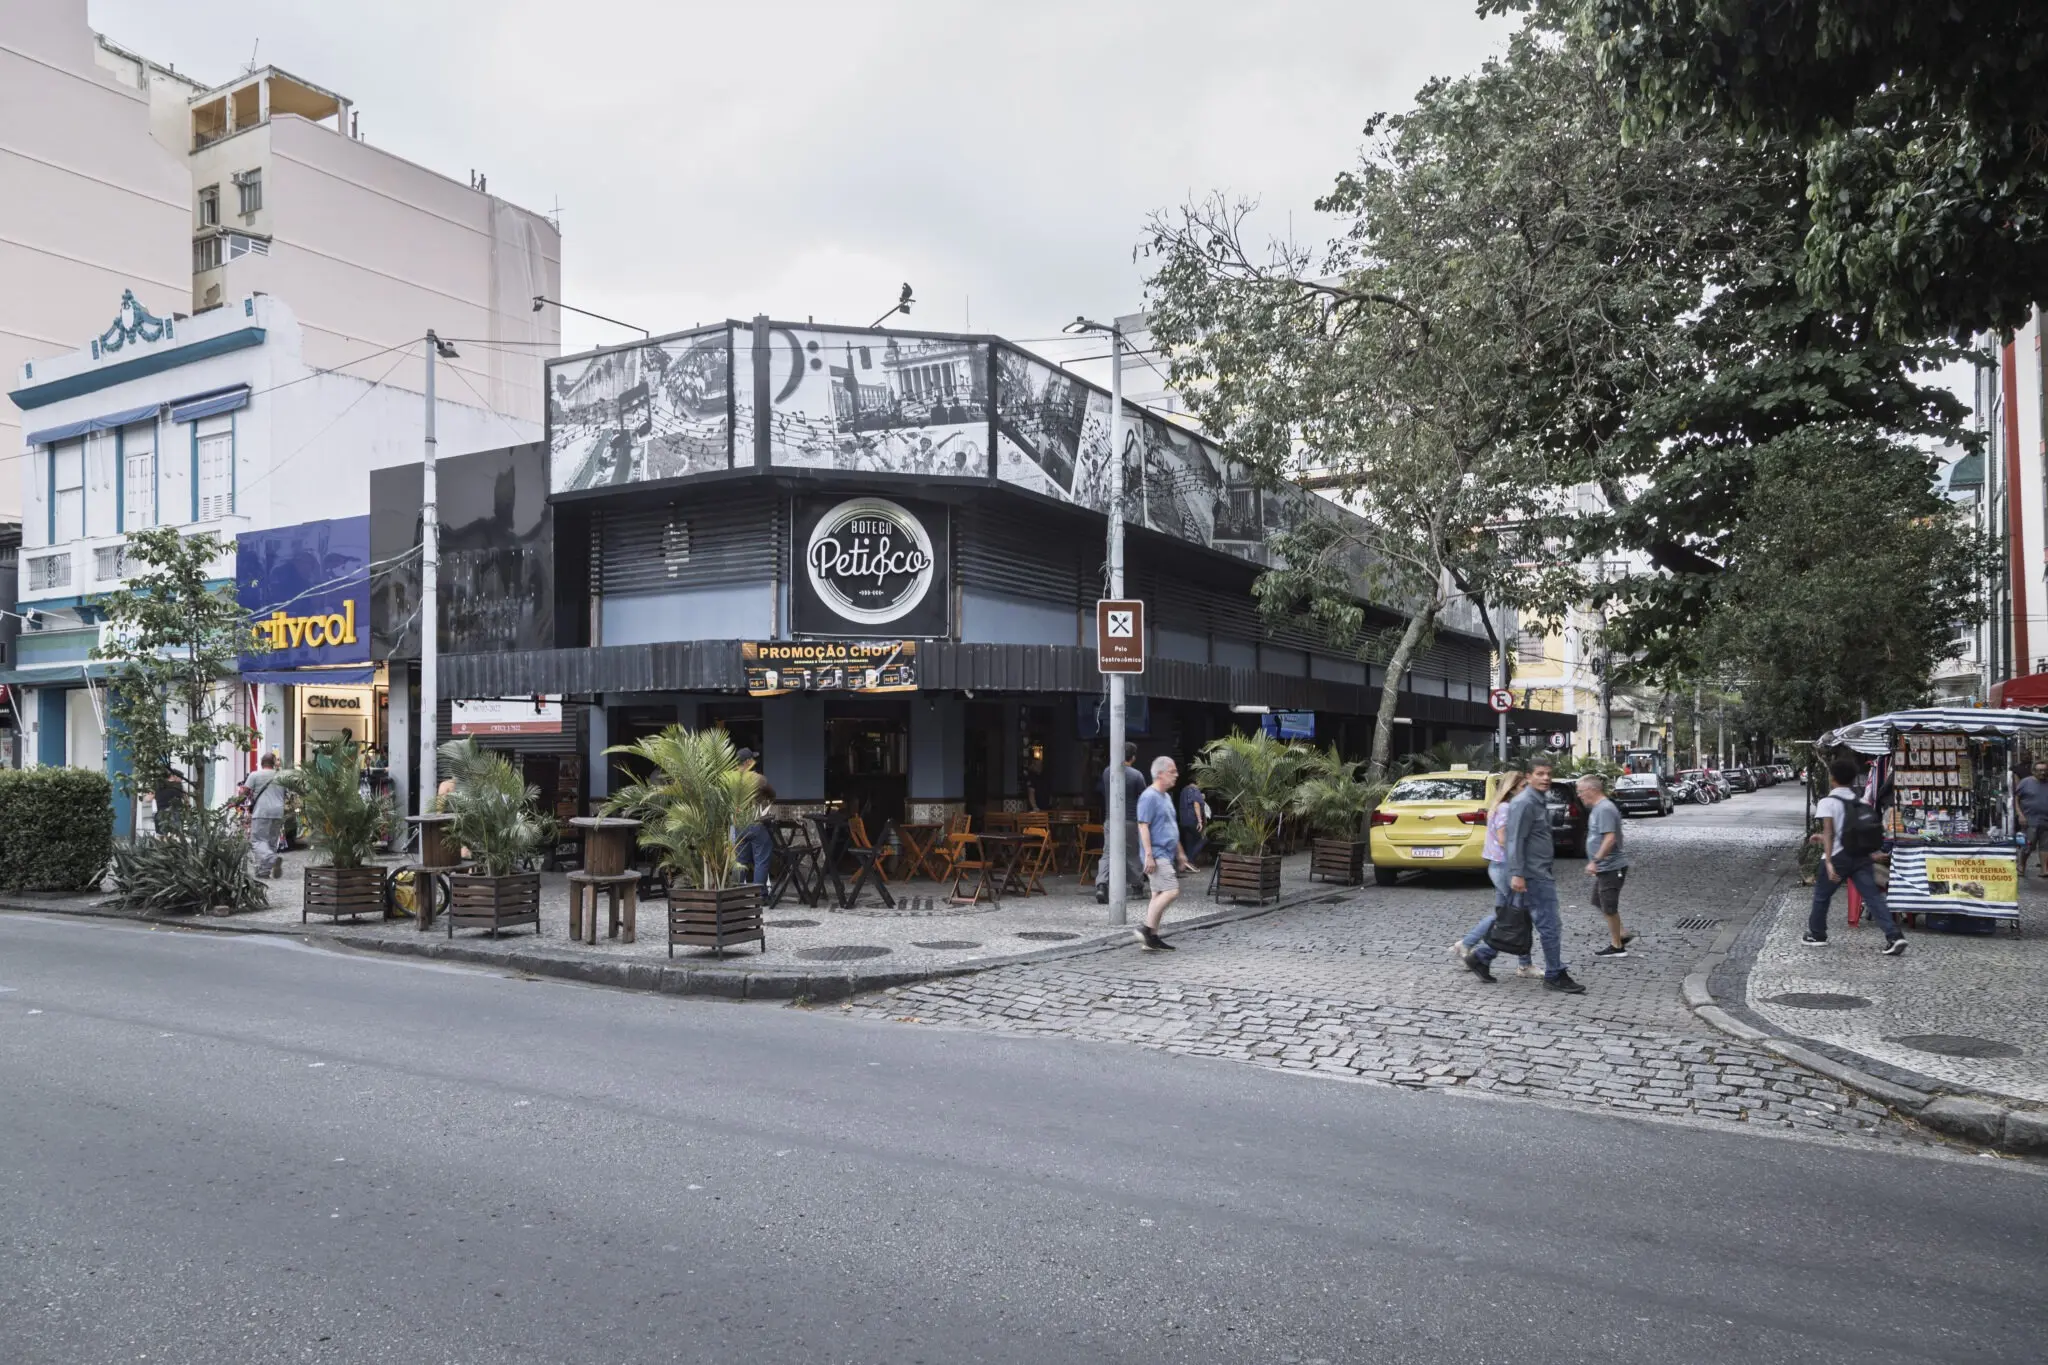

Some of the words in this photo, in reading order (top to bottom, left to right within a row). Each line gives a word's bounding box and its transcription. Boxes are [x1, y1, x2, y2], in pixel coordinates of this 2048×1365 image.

[851, 520, 892, 535] BOTECO
[759, 644, 847, 660] PROMOÇÃO
[307, 695, 361, 709] Citycol
[1555, 735, 1562, 744] E
[1980, 874, 2013, 882] RELÓGIOS
